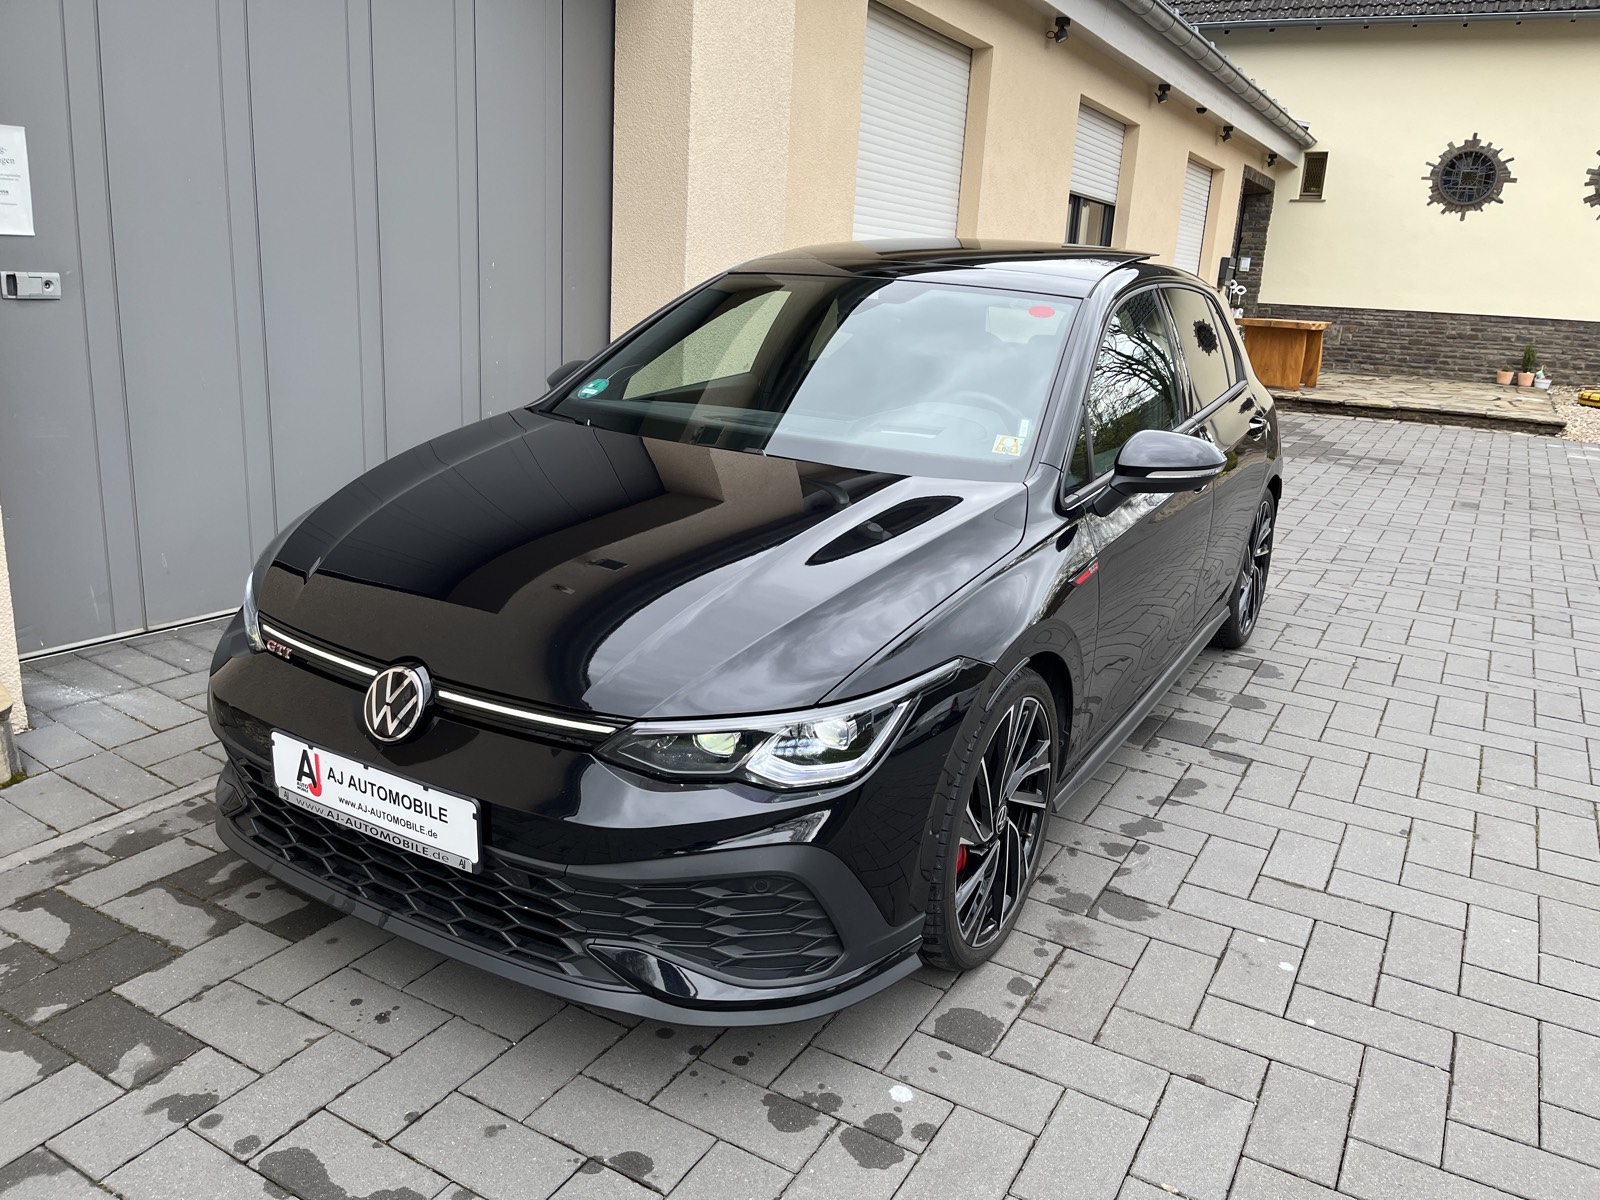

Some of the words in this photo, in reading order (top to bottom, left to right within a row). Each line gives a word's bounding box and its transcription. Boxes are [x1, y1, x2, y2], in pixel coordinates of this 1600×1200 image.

[266, 639, 292, 660] GTI
[296, 749, 322, 797] AJ
[327, 767, 344, 785] AJ
[348, 775, 448, 824] AUTOMOBILE
[296, 798, 449, 863] www.AJ-AUTOMOBILE.de
[338, 796, 438, 839] www.AJ-AUTOMOBILE.de
